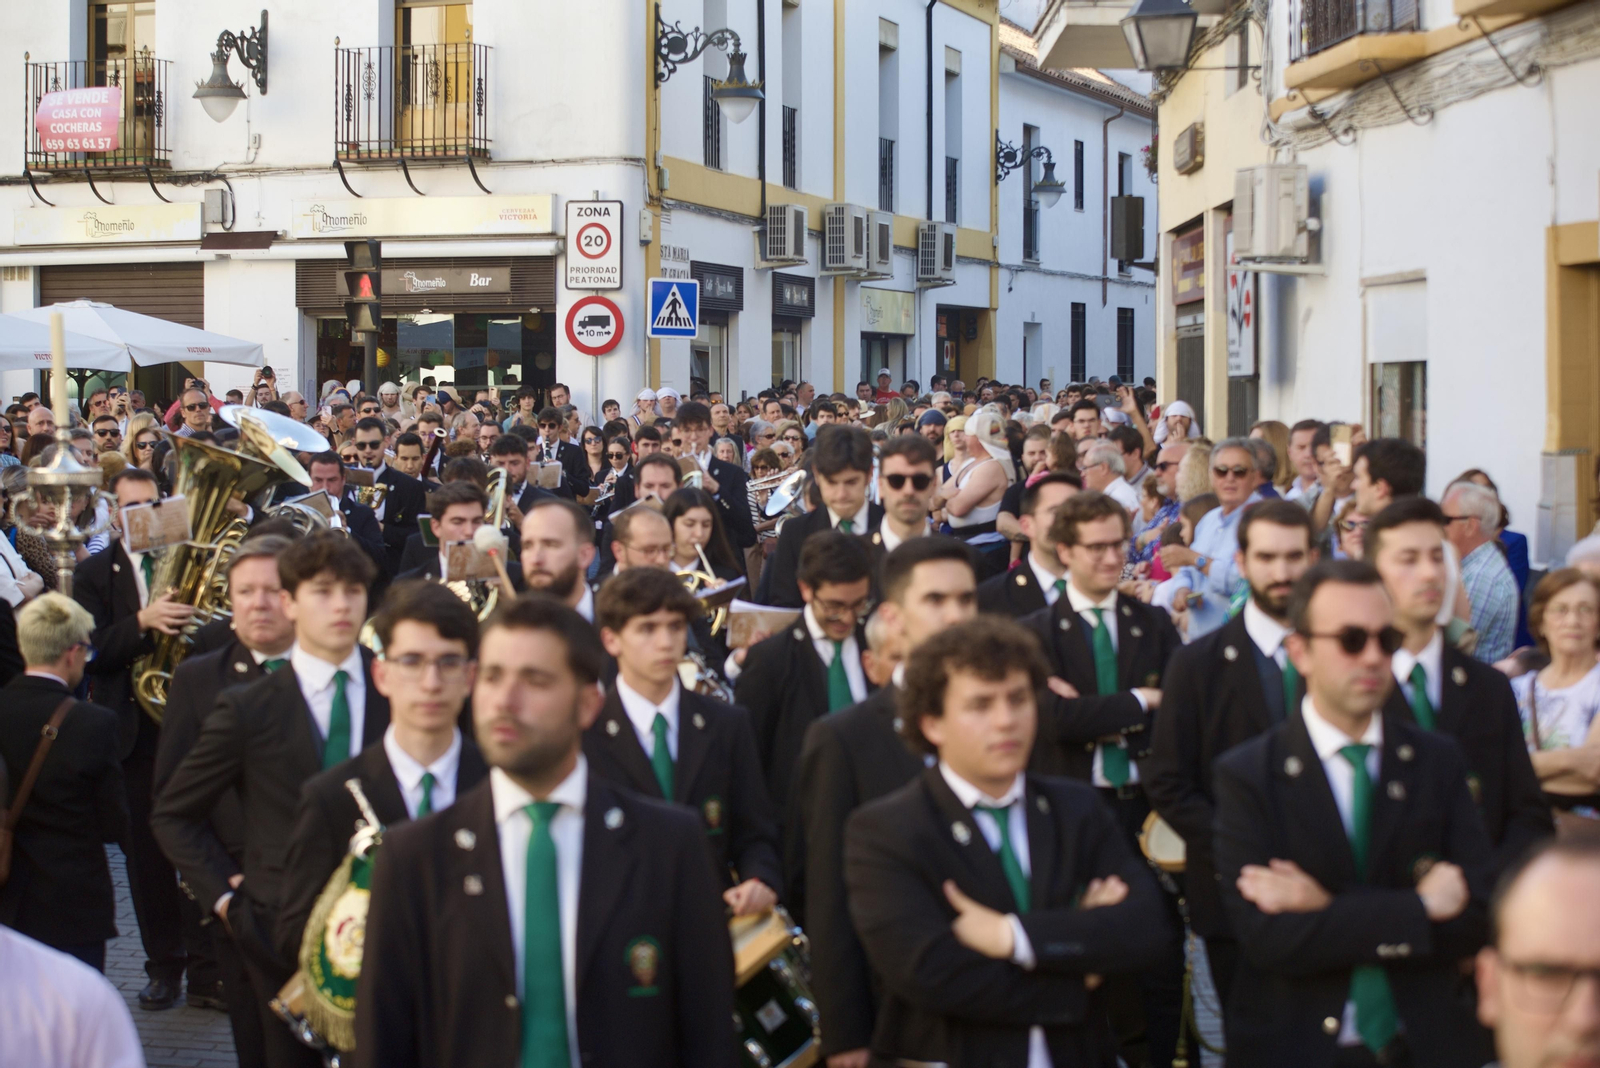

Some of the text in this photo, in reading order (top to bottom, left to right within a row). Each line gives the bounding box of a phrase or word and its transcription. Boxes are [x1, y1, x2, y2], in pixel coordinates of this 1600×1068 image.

[49, 91, 109, 106] SE VENDE
[52, 108, 102, 119] CASA CON
[50, 122, 102, 133] COCHERAS
[46, 137, 112, 150] 659 63 61 57
[499, 213, 538, 221] VICTORIA
[577, 207, 611, 217] ZONA
[584, 235, 604, 247] 20
[570, 266, 617, 274] PRIORIDAD
[469, 272, 492, 287] Bar
[570, 276, 617, 284] PEATONAL
[585, 329, 595, 337] 10
[187, 346, 212, 354] VICTORIA
[34, 353, 54, 361] VICTO
